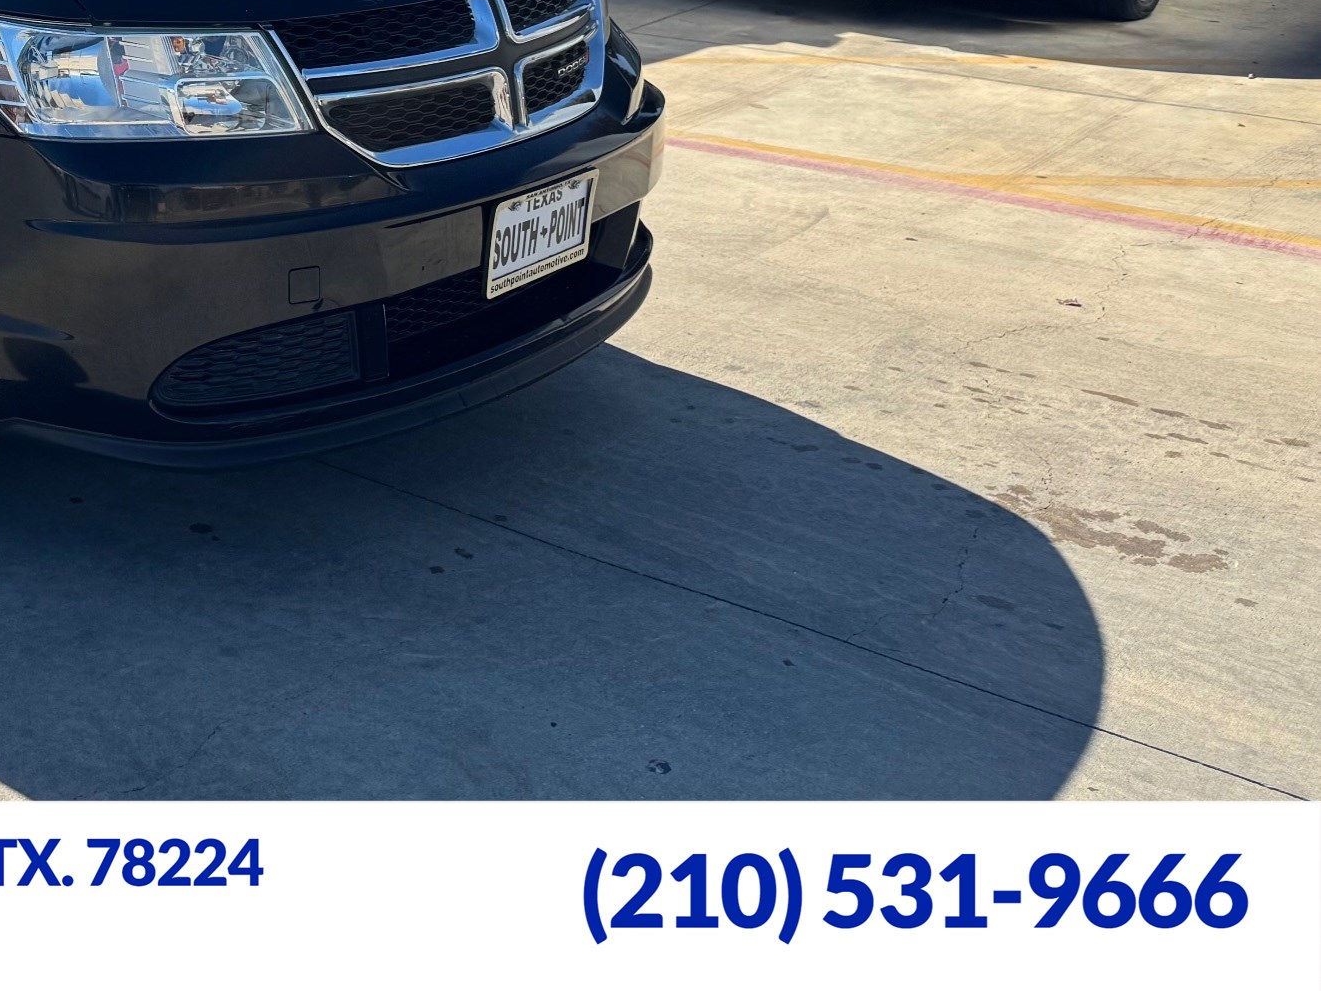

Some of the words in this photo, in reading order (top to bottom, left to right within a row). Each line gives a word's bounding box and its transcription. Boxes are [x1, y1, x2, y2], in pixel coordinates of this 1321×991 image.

[526, 190, 563, 212] TEXAS
[493, 217, 539, 270] SOUTH
[547, 198, 585, 248] POINT
[490, 248, 584, 294] southpointautomotive.com
